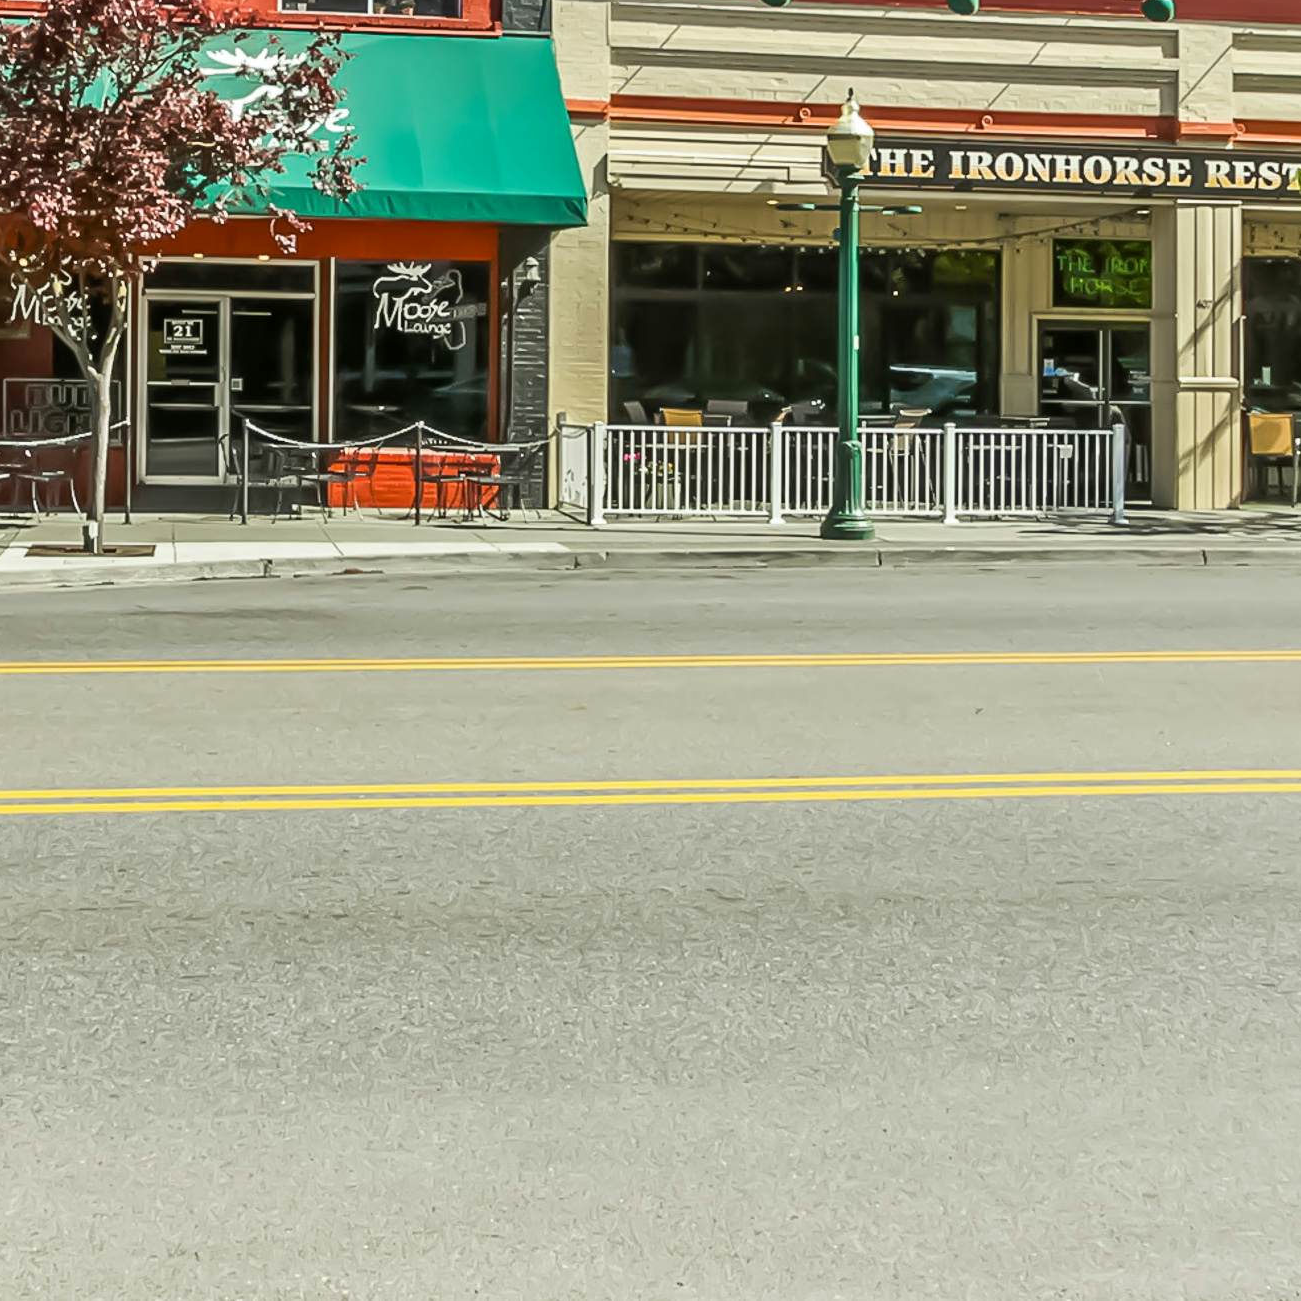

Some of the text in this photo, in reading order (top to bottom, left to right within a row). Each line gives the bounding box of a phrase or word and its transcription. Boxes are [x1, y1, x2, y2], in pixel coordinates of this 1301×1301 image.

[859, 148, 935, 179] THE
[948, 150, 1192, 187] IRONHORSE
[374, 293, 450, 332] Moose
[173, 325, 193, 337] 21
[404, 320, 451, 339] Lounge
[11, 410, 92, 435] LIGH
